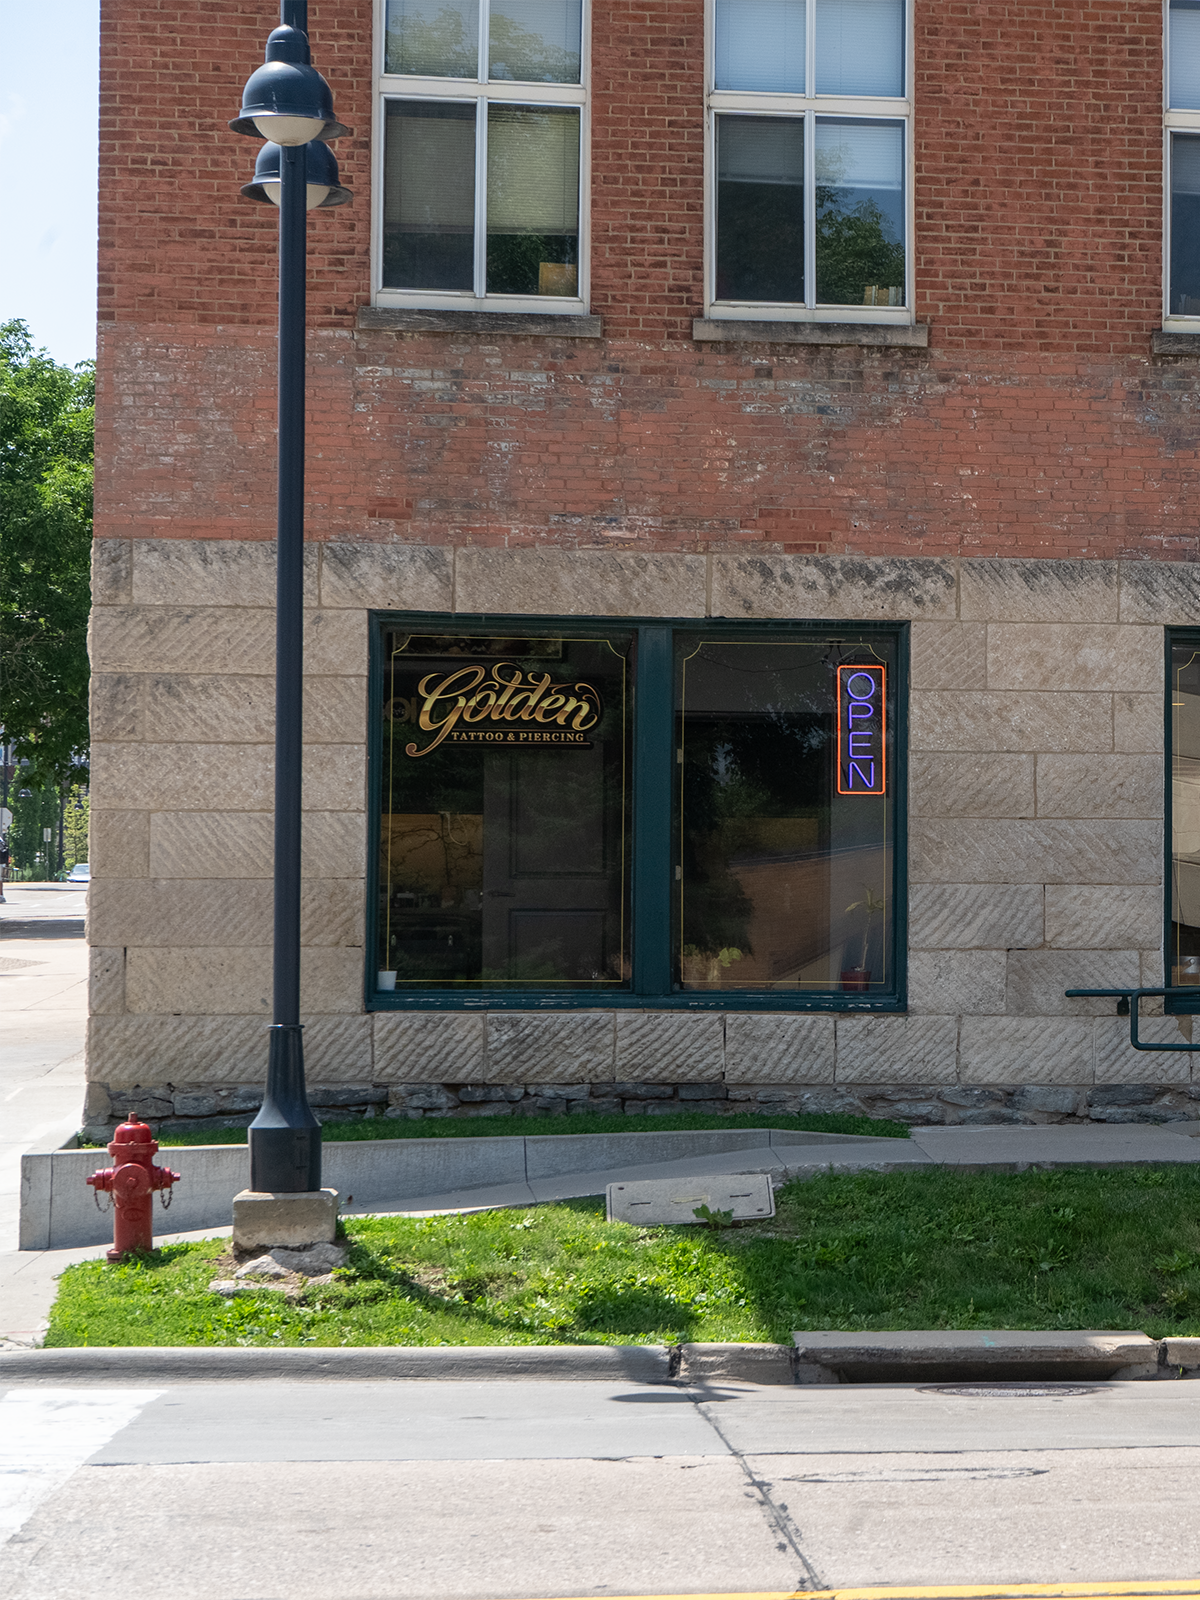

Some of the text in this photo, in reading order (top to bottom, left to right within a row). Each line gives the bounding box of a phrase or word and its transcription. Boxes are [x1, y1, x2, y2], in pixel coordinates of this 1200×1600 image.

[405, 662, 600, 757] Golden
[451, 732, 584, 742] TATTOO & PIERCING
[847, 672, 875, 788] OPEN
